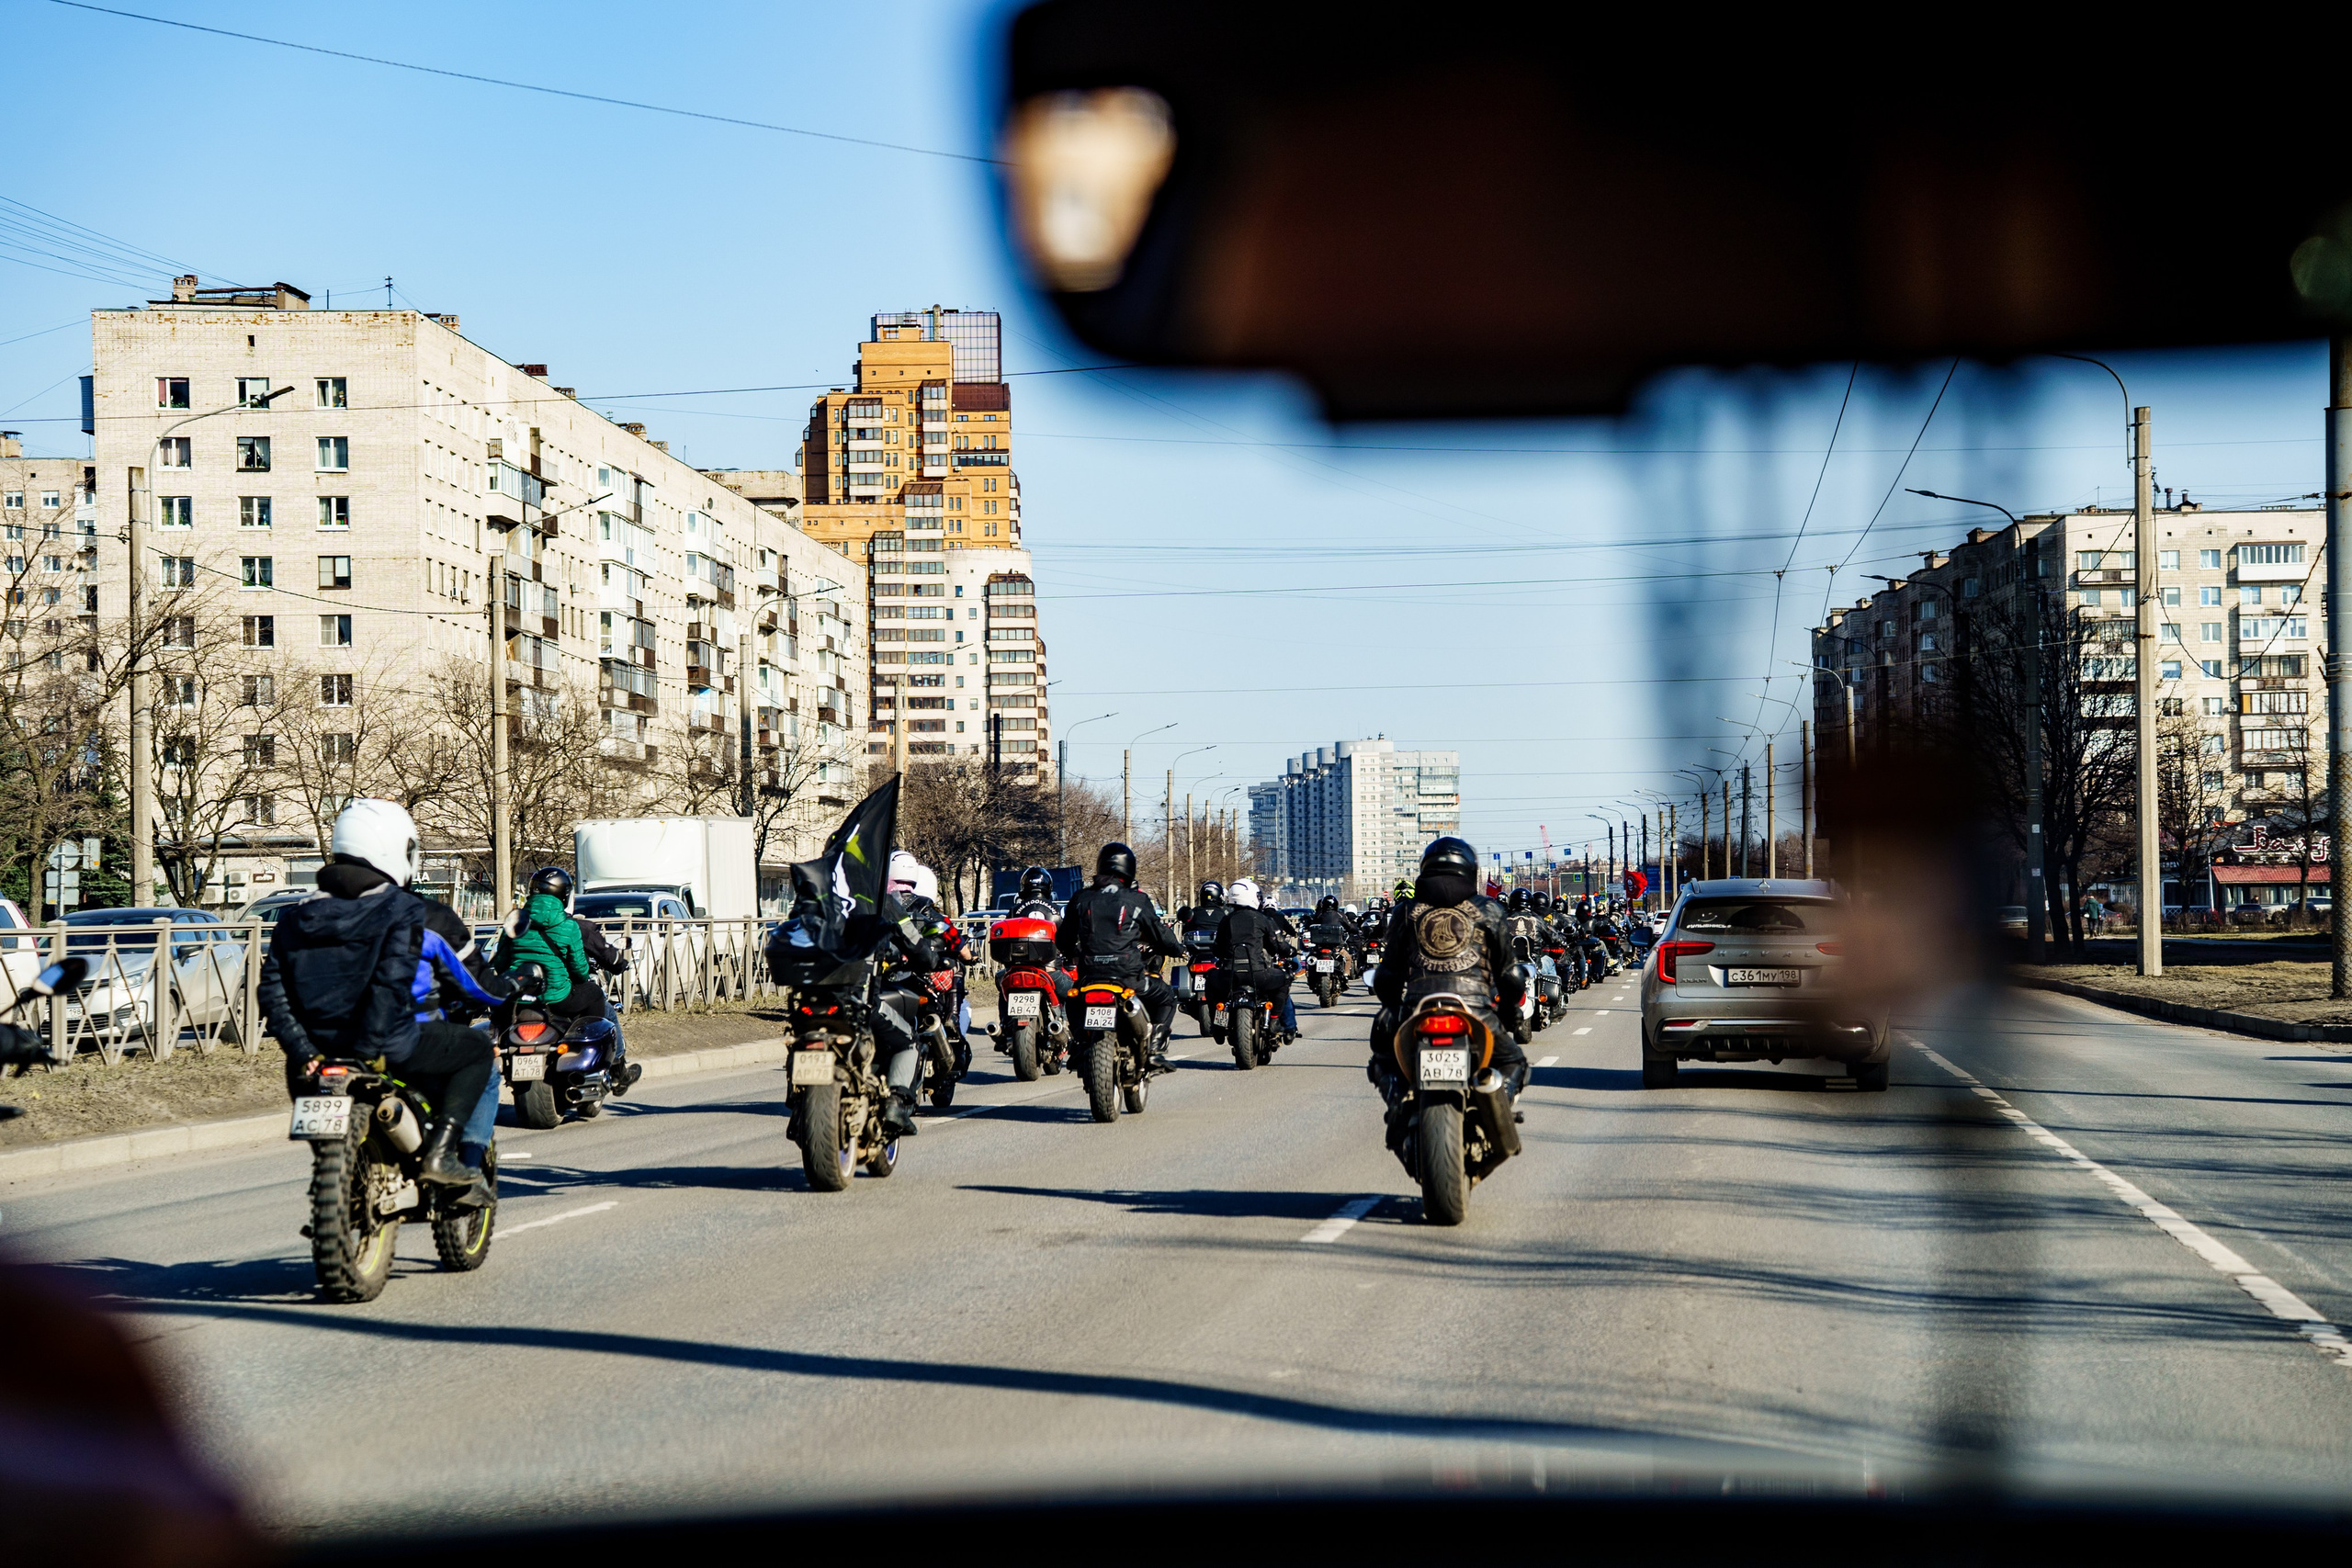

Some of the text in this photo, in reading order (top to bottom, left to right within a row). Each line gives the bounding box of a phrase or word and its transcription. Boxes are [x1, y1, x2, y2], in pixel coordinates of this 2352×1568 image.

[1731, 970, 1796, 982] С361МУ 198
[1013, 995, 1035, 1003] 9298
[1010, 1006, 1036, 1014] АВ 47
[1091, 1008, 1112, 1016] 5108
[517, 1057, 538, 1066] 0964
[1427, 1053, 1460, 1063] 3025
[514, 1067, 541, 1077] АТ 78
[816, 1069, 829, 1079] 78
[1423, 1068, 1463, 1078] АВ 78
[301, 1100, 343, 1113] 5899
[294, 1119, 343, 1133] АС 78
